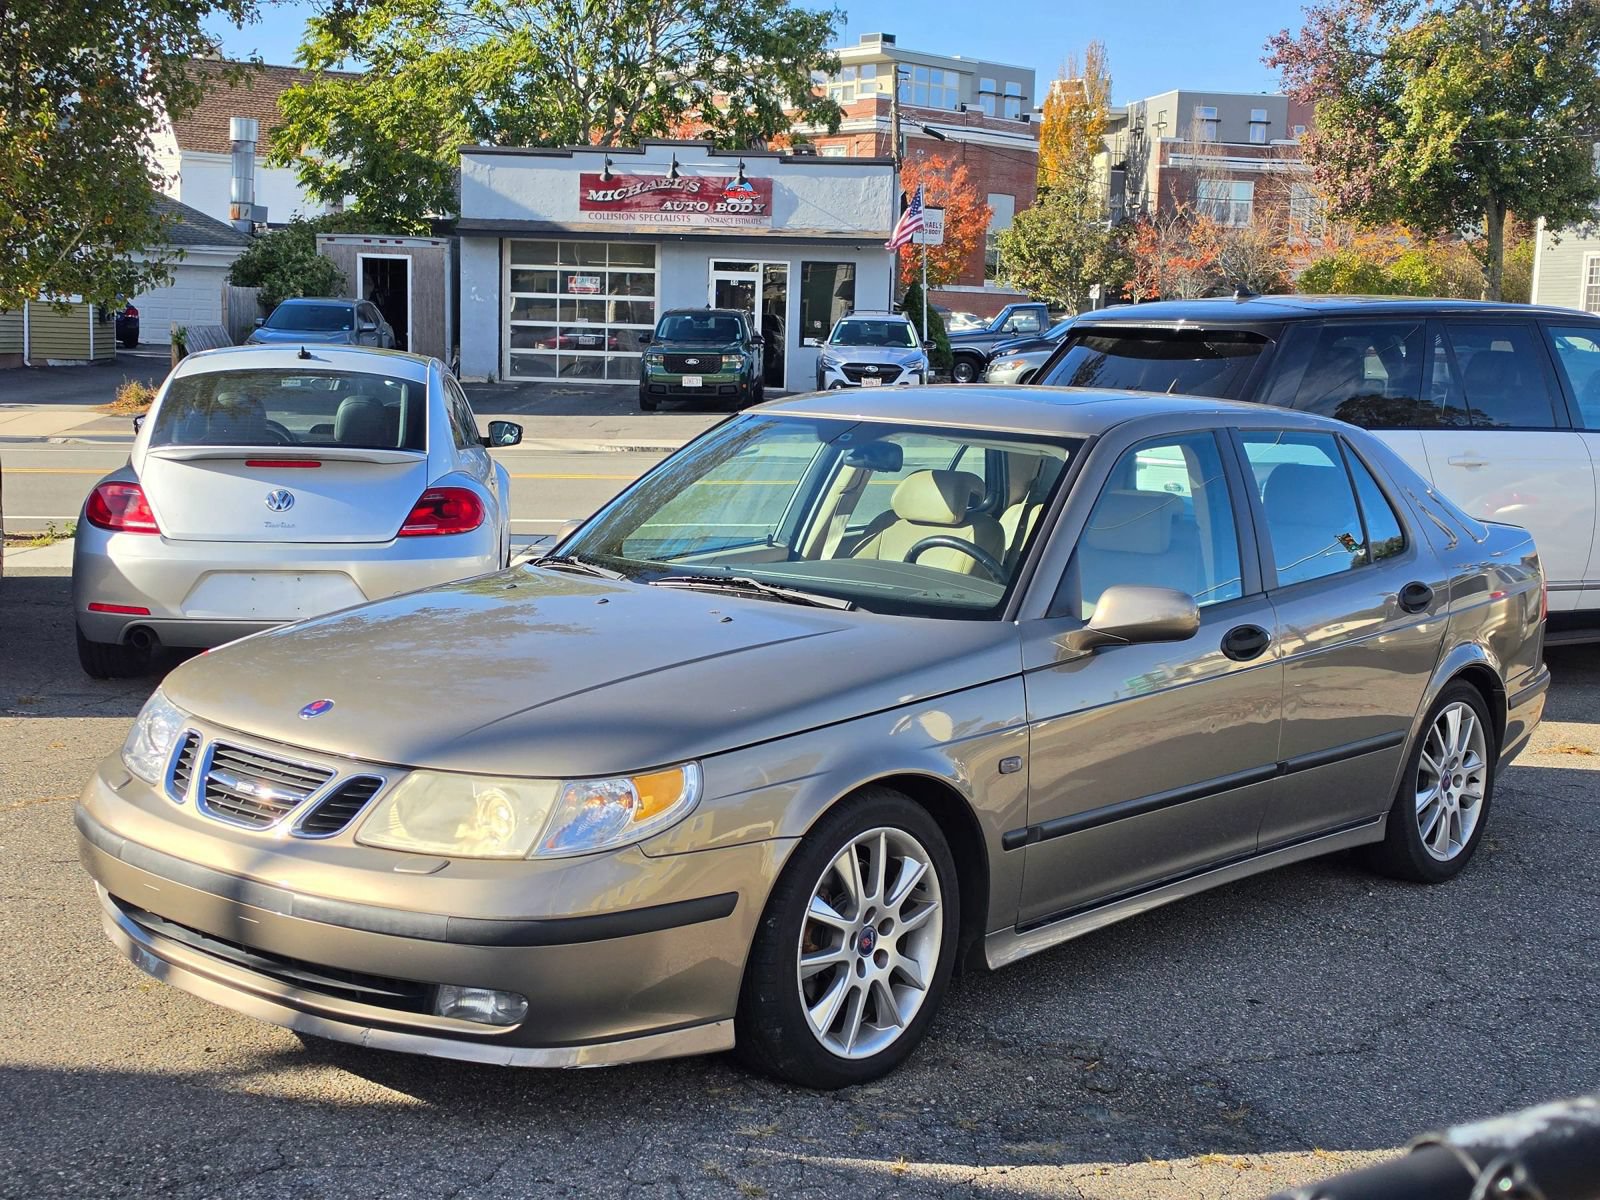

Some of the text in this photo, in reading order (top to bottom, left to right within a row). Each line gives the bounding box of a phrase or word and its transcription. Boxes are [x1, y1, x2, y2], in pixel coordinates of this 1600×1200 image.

[586, 178, 700, 201] MICHAEL'S
[660, 201, 765, 213] AUTO BODY
[588, 212, 691, 222] COLLISION SPECIALISTS
